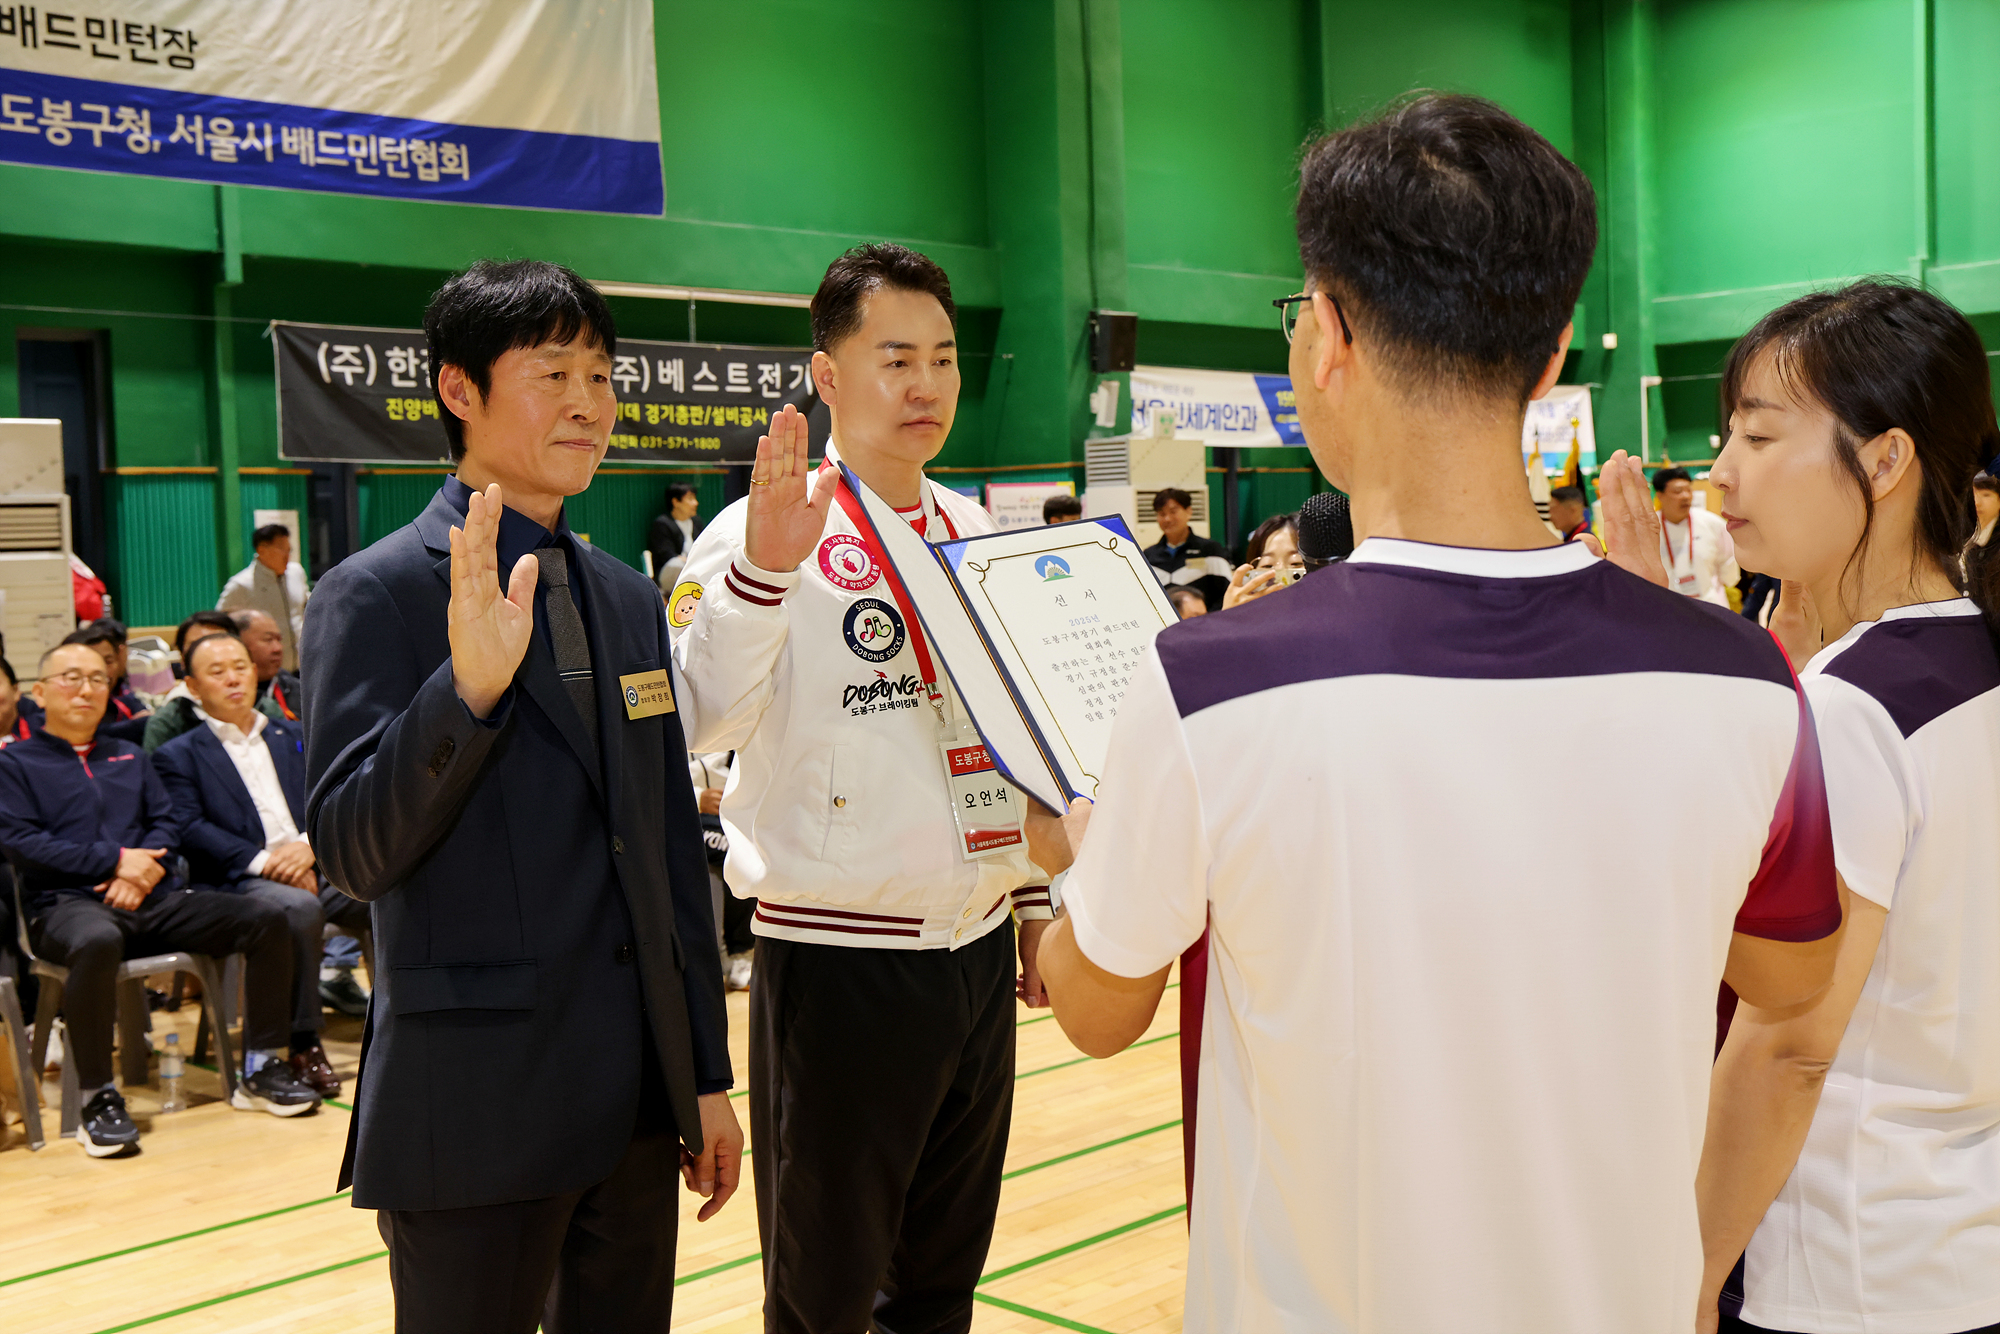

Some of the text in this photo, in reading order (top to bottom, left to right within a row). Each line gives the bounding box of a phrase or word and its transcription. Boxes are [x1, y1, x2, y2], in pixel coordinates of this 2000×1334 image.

[0, 4, 198, 70] 배드민턴장
[0, 93, 470, 183] 도봉구청, 서울시 배드민턴협회
[317, 341, 431, 388] (주) 한
[612, 354, 814, 398] 주) 베스트전기
[640, 435, 721, 450] 031-571-1800
[855, 601, 880, 612] SEOUL
[1068, 613, 1100, 627] 2025년
[1042, 619, 1140, 646] 도봉구청장기 배드민턴
[852, 636, 903, 661] DOBONG SOCKS
[1084, 638, 1113, 651] 대회에
[1108, 650, 1126, 661] 선수
[1065, 672, 1085, 683] 경기
[1089, 665, 1117, 678] 규정을
[843, 674, 919, 709] DOBONG
[851, 698, 919, 717] 도봉구 브레이킹팀
[703, 830, 730, 852] YON
